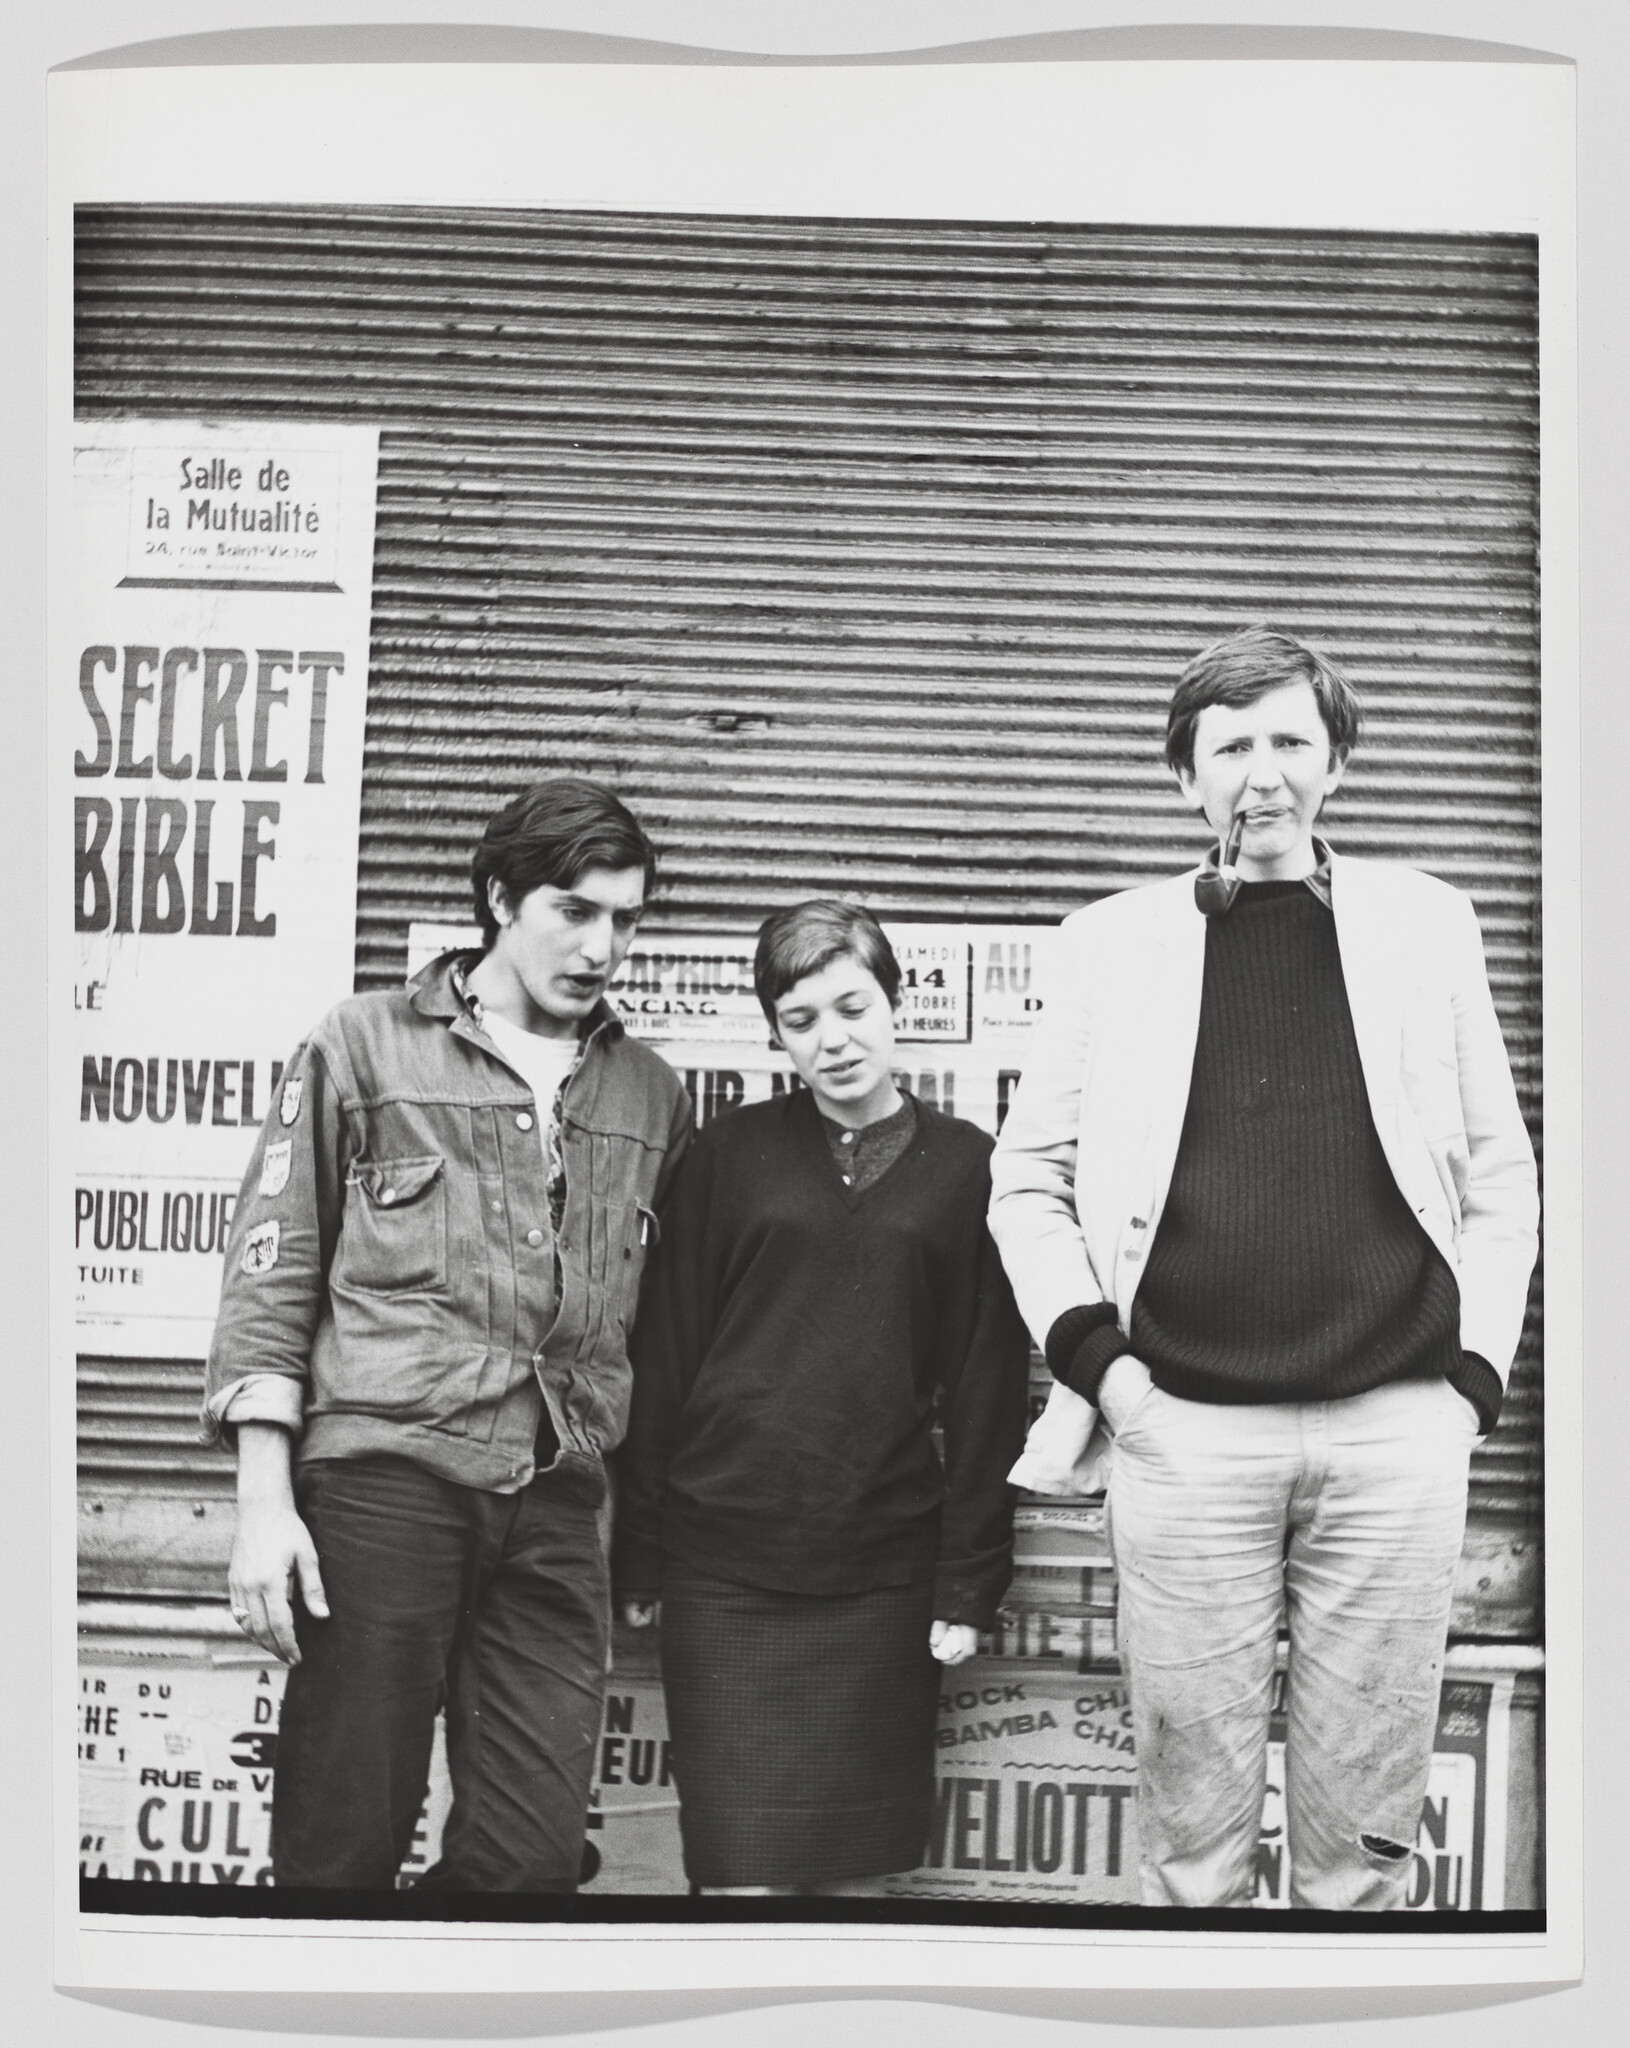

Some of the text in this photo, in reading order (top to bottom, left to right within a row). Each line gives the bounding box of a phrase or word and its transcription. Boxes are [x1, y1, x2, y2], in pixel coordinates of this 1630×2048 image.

[179, 456, 290, 491] Salle de
[146, 497, 319, 534] la Mutualité
[74, 645, 345, 783] SECRET
[74, 796, 280, 937] BIBLE
[608, 953, 757, 996] APRICE
[906, 968, 946, 988] 14
[75, 1188, 237, 1254] PUBLIQUE
[138, 1683, 172, 1699] DU
[78, 1704, 119, 1736] HE
[937, 1710, 1057, 1749] BAMBA
[1074, 1720, 1136, 1756] CHA
[140, 1768, 202, 1789] RUE
[212, 1779, 239, 1791] DE
